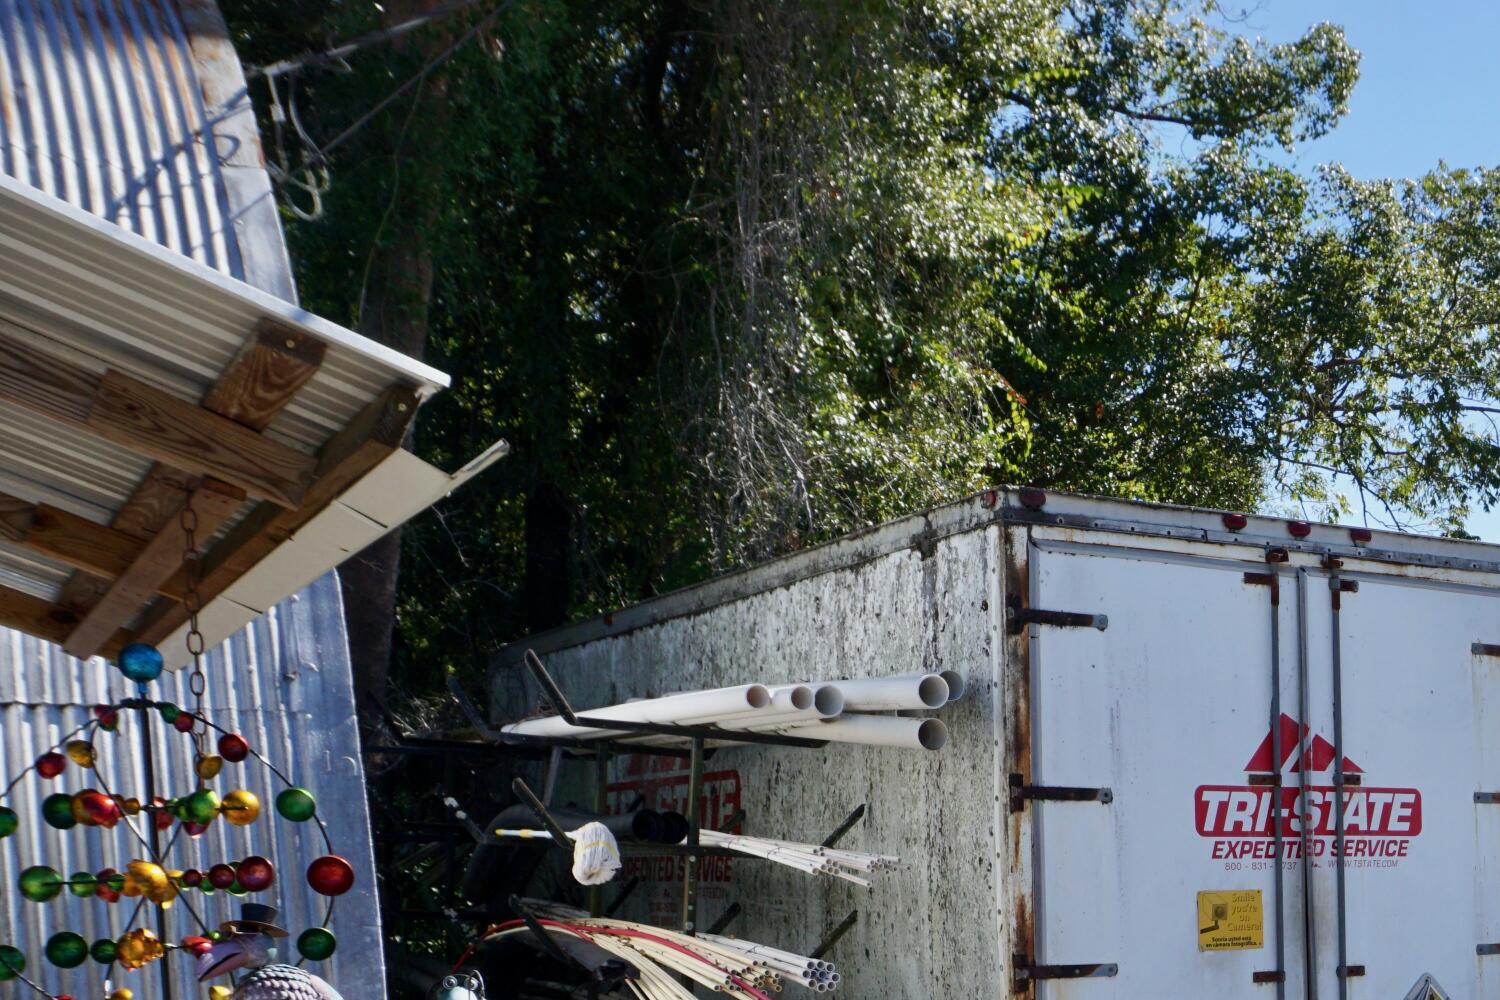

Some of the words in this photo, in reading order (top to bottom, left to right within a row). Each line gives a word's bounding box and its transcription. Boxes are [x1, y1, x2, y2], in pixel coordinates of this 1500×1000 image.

[1202, 791, 1416, 832] TRI-STATE
[1212, 839, 1325, 859] EXPEDITED
[1331, 839, 1409, 857] SERVICE
[1225, 862, 1241, 870] 800
[1328, 860, 1398, 868] WW.TSTATE.COM
